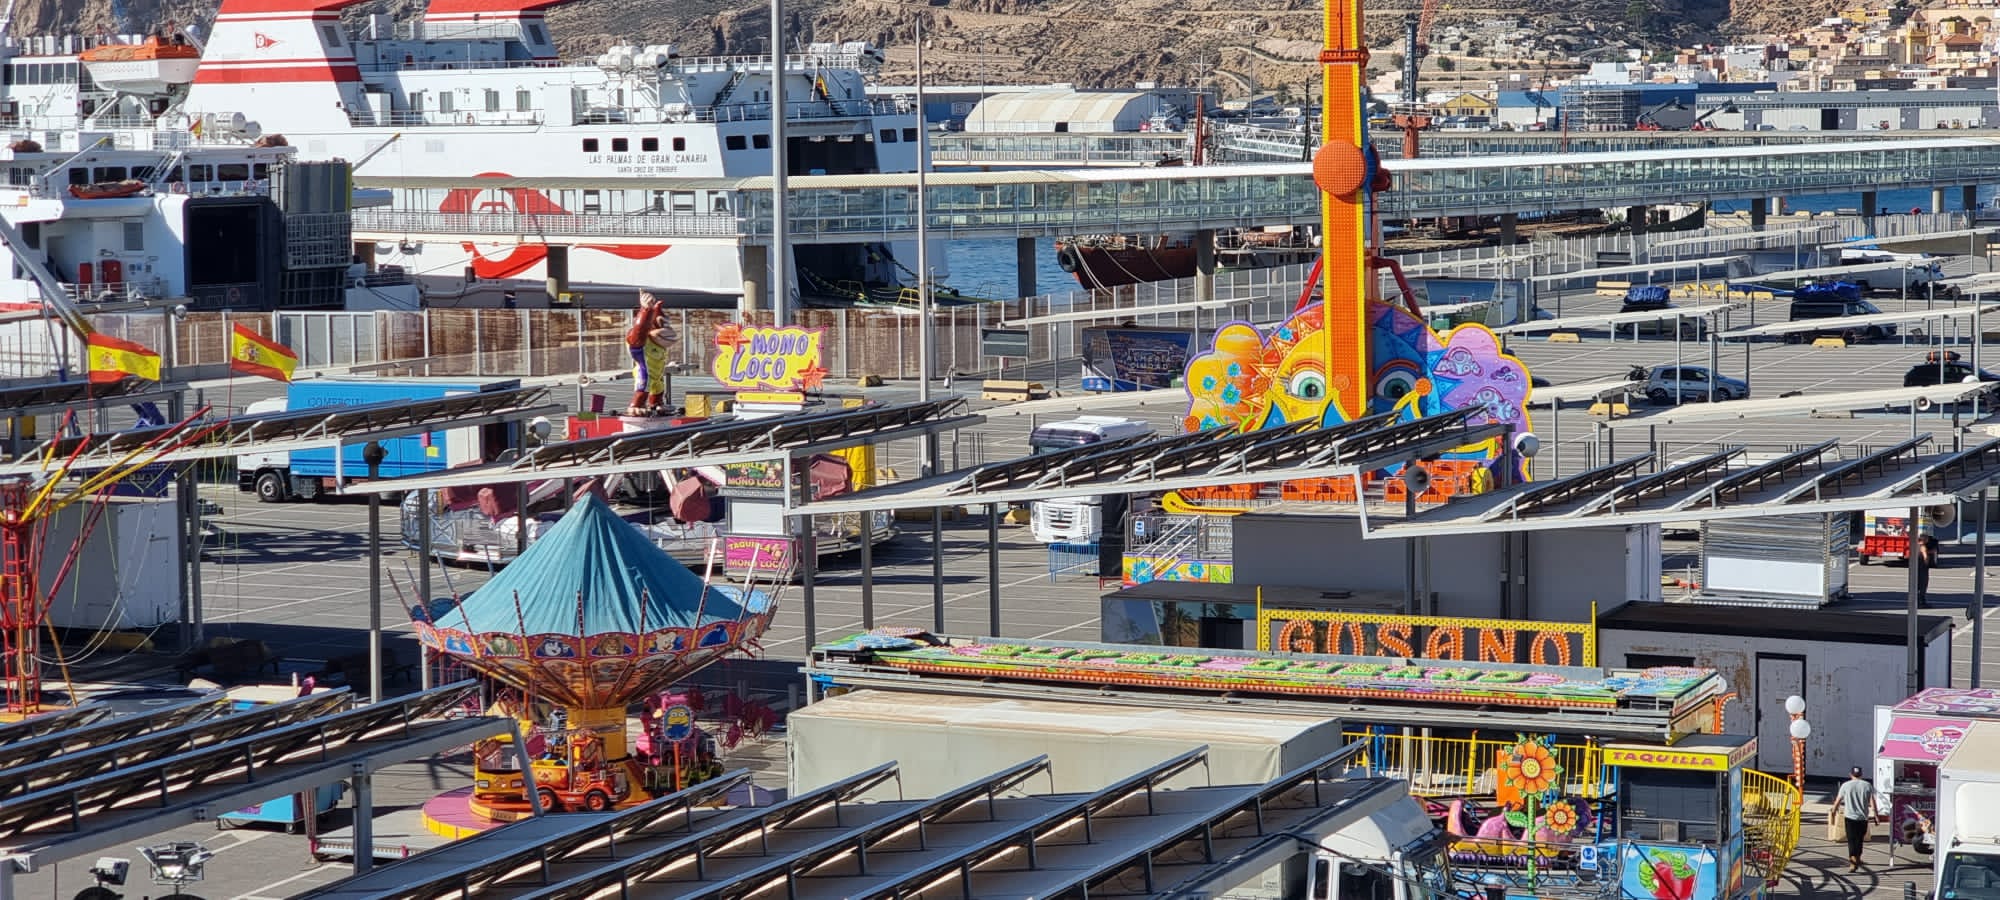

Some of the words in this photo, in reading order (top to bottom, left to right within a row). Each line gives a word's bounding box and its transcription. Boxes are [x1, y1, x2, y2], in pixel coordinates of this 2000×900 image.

[589, 155, 601, 164] LAS
[607, 155, 632, 164] PALMAS
[637, 155, 645, 164] DE
[651, 155, 670, 163] GRAN
[676, 154, 708, 163] CANARIA
[751, 333, 809, 355] MONO
[729, 345, 786, 382] LOCO
[727, 478, 755, 486] MONO
[758, 479, 781, 487] LOCO
[1613, 751, 1715, 766] TAQUILLA
